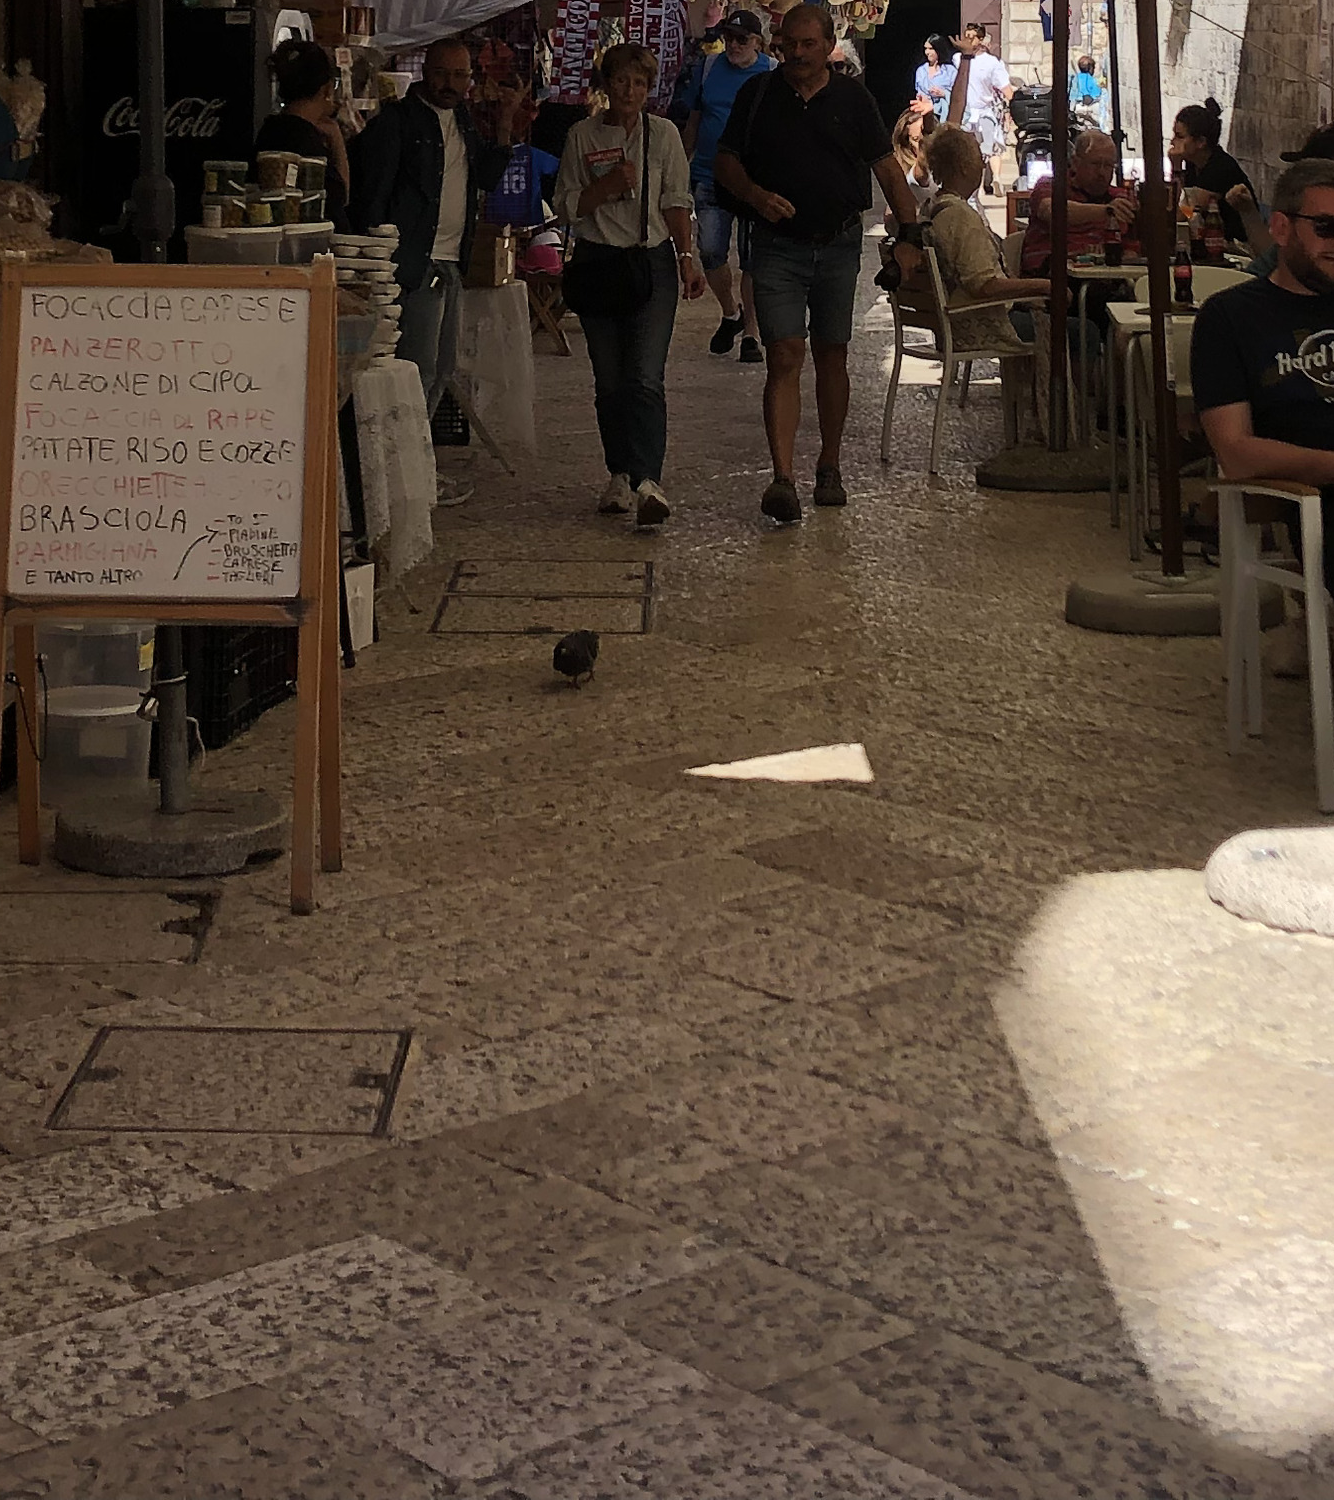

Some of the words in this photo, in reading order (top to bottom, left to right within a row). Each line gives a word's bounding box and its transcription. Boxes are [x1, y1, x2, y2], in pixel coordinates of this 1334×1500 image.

[627, 25, 640, 45] 190
[30, 291, 172, 322] FOCACCIA
[30, 336, 233, 365] PANZEROTTO
[1275, 344, 1327, 375] Hard
[29, 372, 149, 396] CALZONE
[159, 373, 179, 394] DI
[207, 408, 275, 431] RAPE
[128, 436, 188, 465] RISO
[198, 439, 215, 463] E
[220, 439, 296, 465] COZZE
[19, 504, 188, 534] BRASCIOLA
[26, 570, 36, 584] E
[44, 570, 94, 584] TANTO
